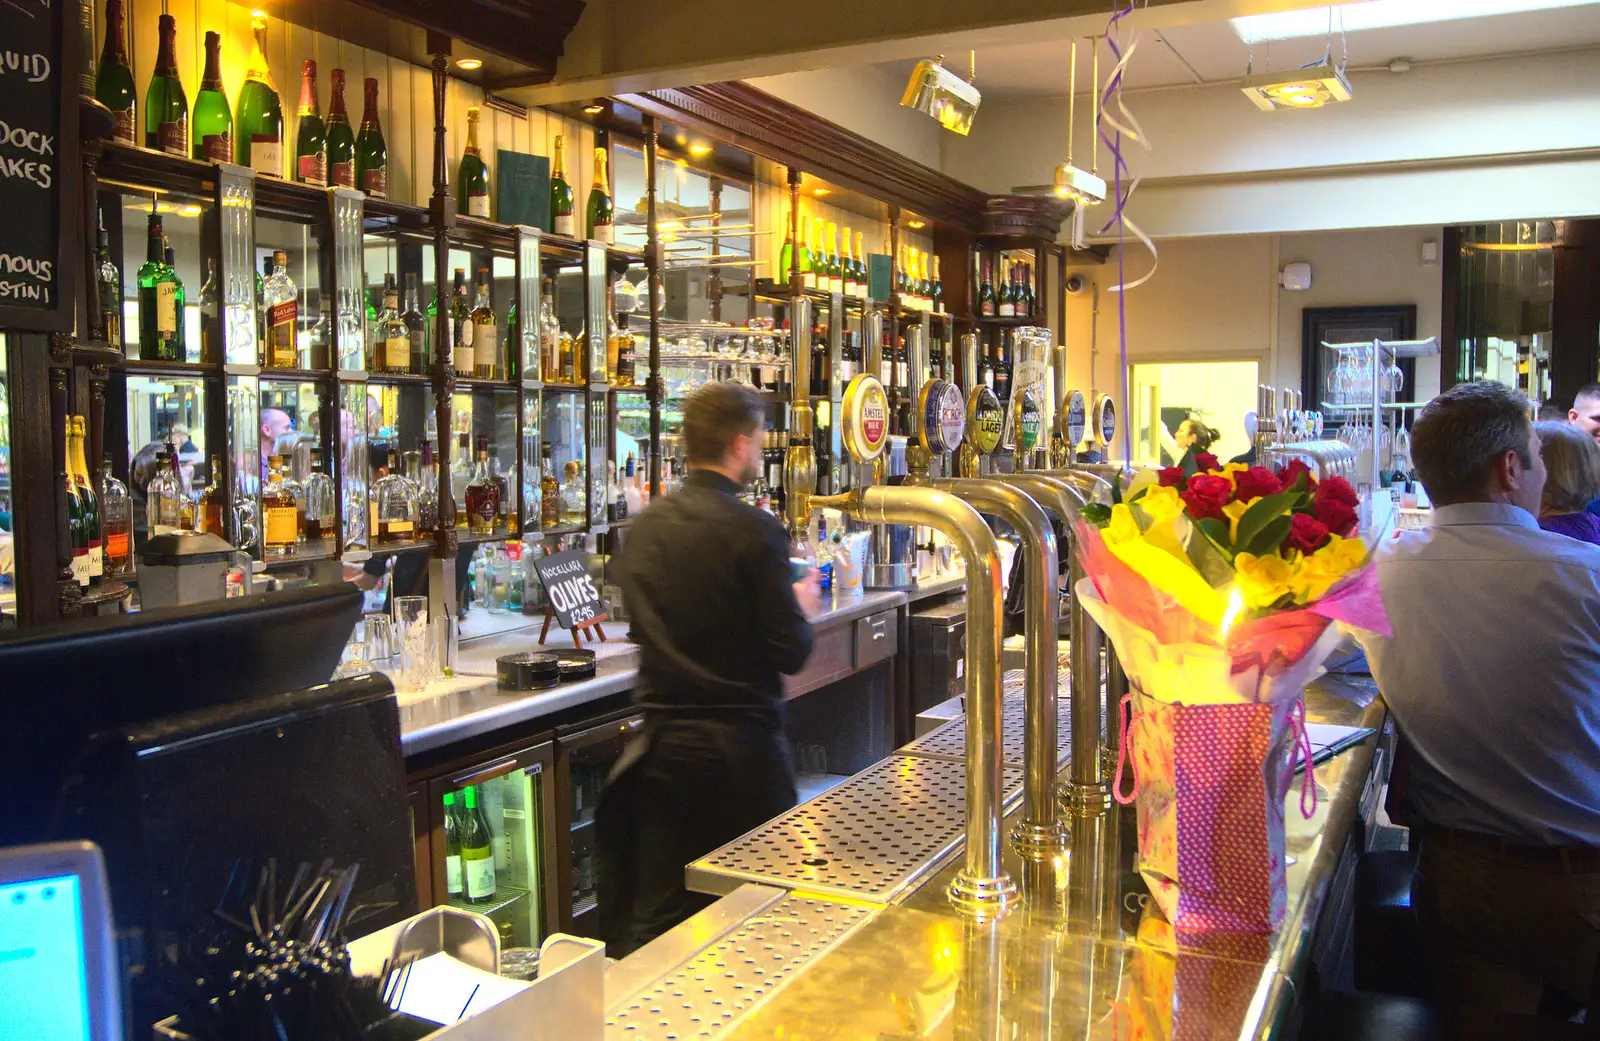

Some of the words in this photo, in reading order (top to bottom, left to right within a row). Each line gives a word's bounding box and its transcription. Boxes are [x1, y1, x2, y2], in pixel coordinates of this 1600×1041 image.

[864, 408, 884, 419] AMSTEL
[541, 560, 584, 580] NOCELLARA
[550, 574, 599, 612] OLIVES
